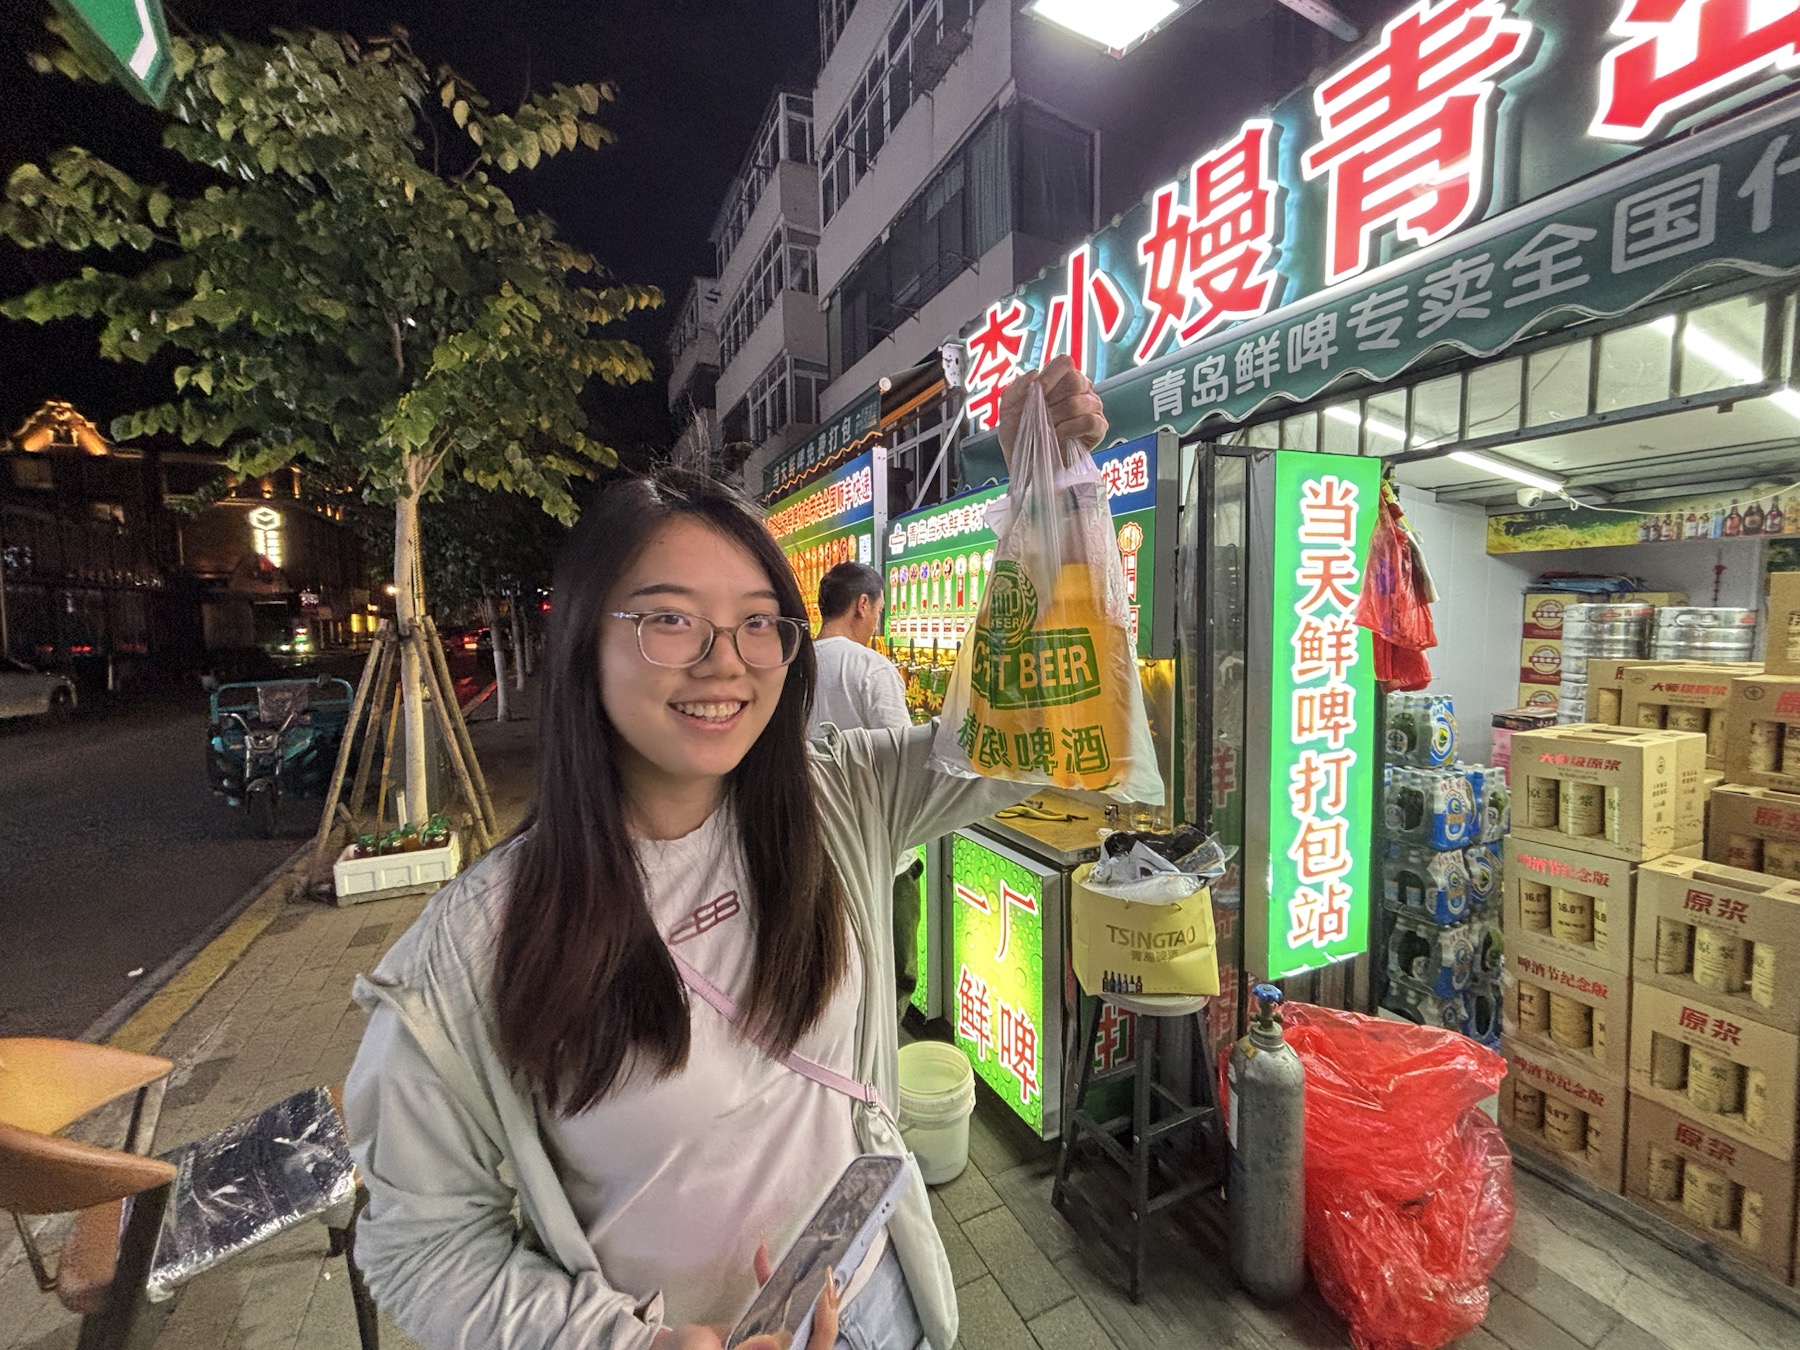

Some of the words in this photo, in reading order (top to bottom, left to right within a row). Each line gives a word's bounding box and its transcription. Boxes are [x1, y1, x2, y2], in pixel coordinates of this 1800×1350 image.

[1019, 644, 1093, 689] BEER
[1288, 476, 1358, 949] 当天鲜啤打包站
[955, 879, 1039, 961] 一厂
[1683, 889, 1749, 924] 原浆
[1106, 925, 1196, 950] TSINGTAO
[1518, 955, 1609, 999] 啤酒节纪念版
[957, 962, 1040, 1104] 鲜啤
[1678, 1006, 1742, 1047] 原浆
[1513, 1055, 1605, 1107] 啤酒节纪念版
[1674, 1123, 1736, 1166] 原浆
